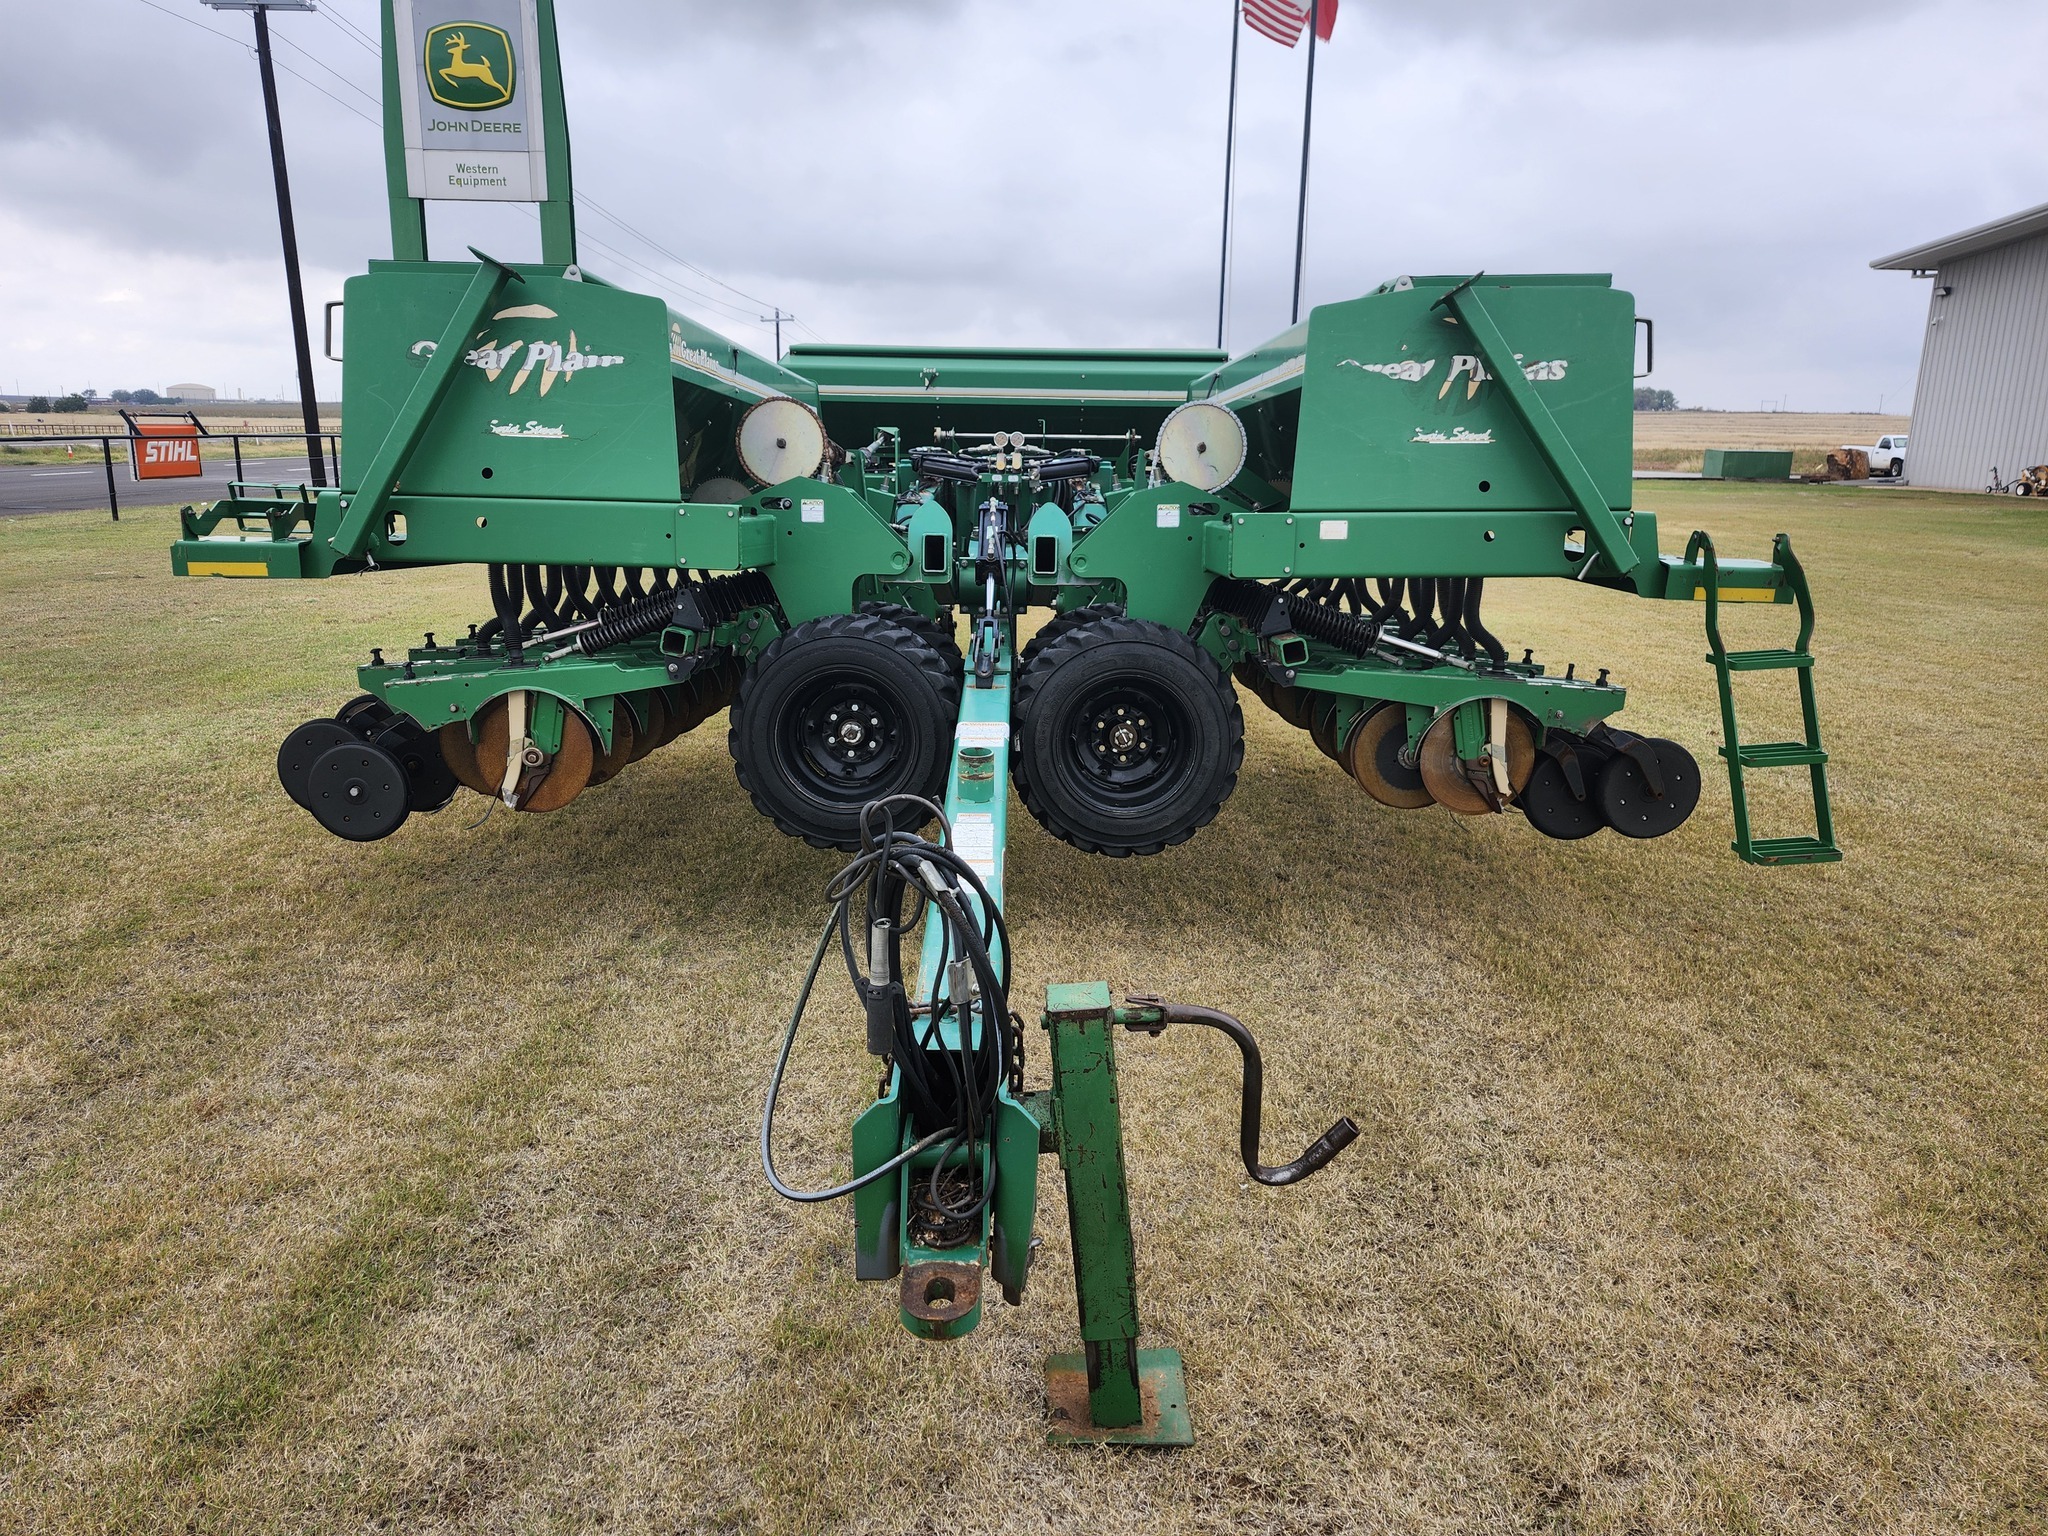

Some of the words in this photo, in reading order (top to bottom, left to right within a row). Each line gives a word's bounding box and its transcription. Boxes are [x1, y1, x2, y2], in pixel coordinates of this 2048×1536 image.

[428, 119, 469, 132] JOHN
[471, 120, 522, 133] DEERE
[456, 163, 499, 174] Western
[448, 175, 507, 187] Equipment
[144, 440, 197, 463] STIHL
